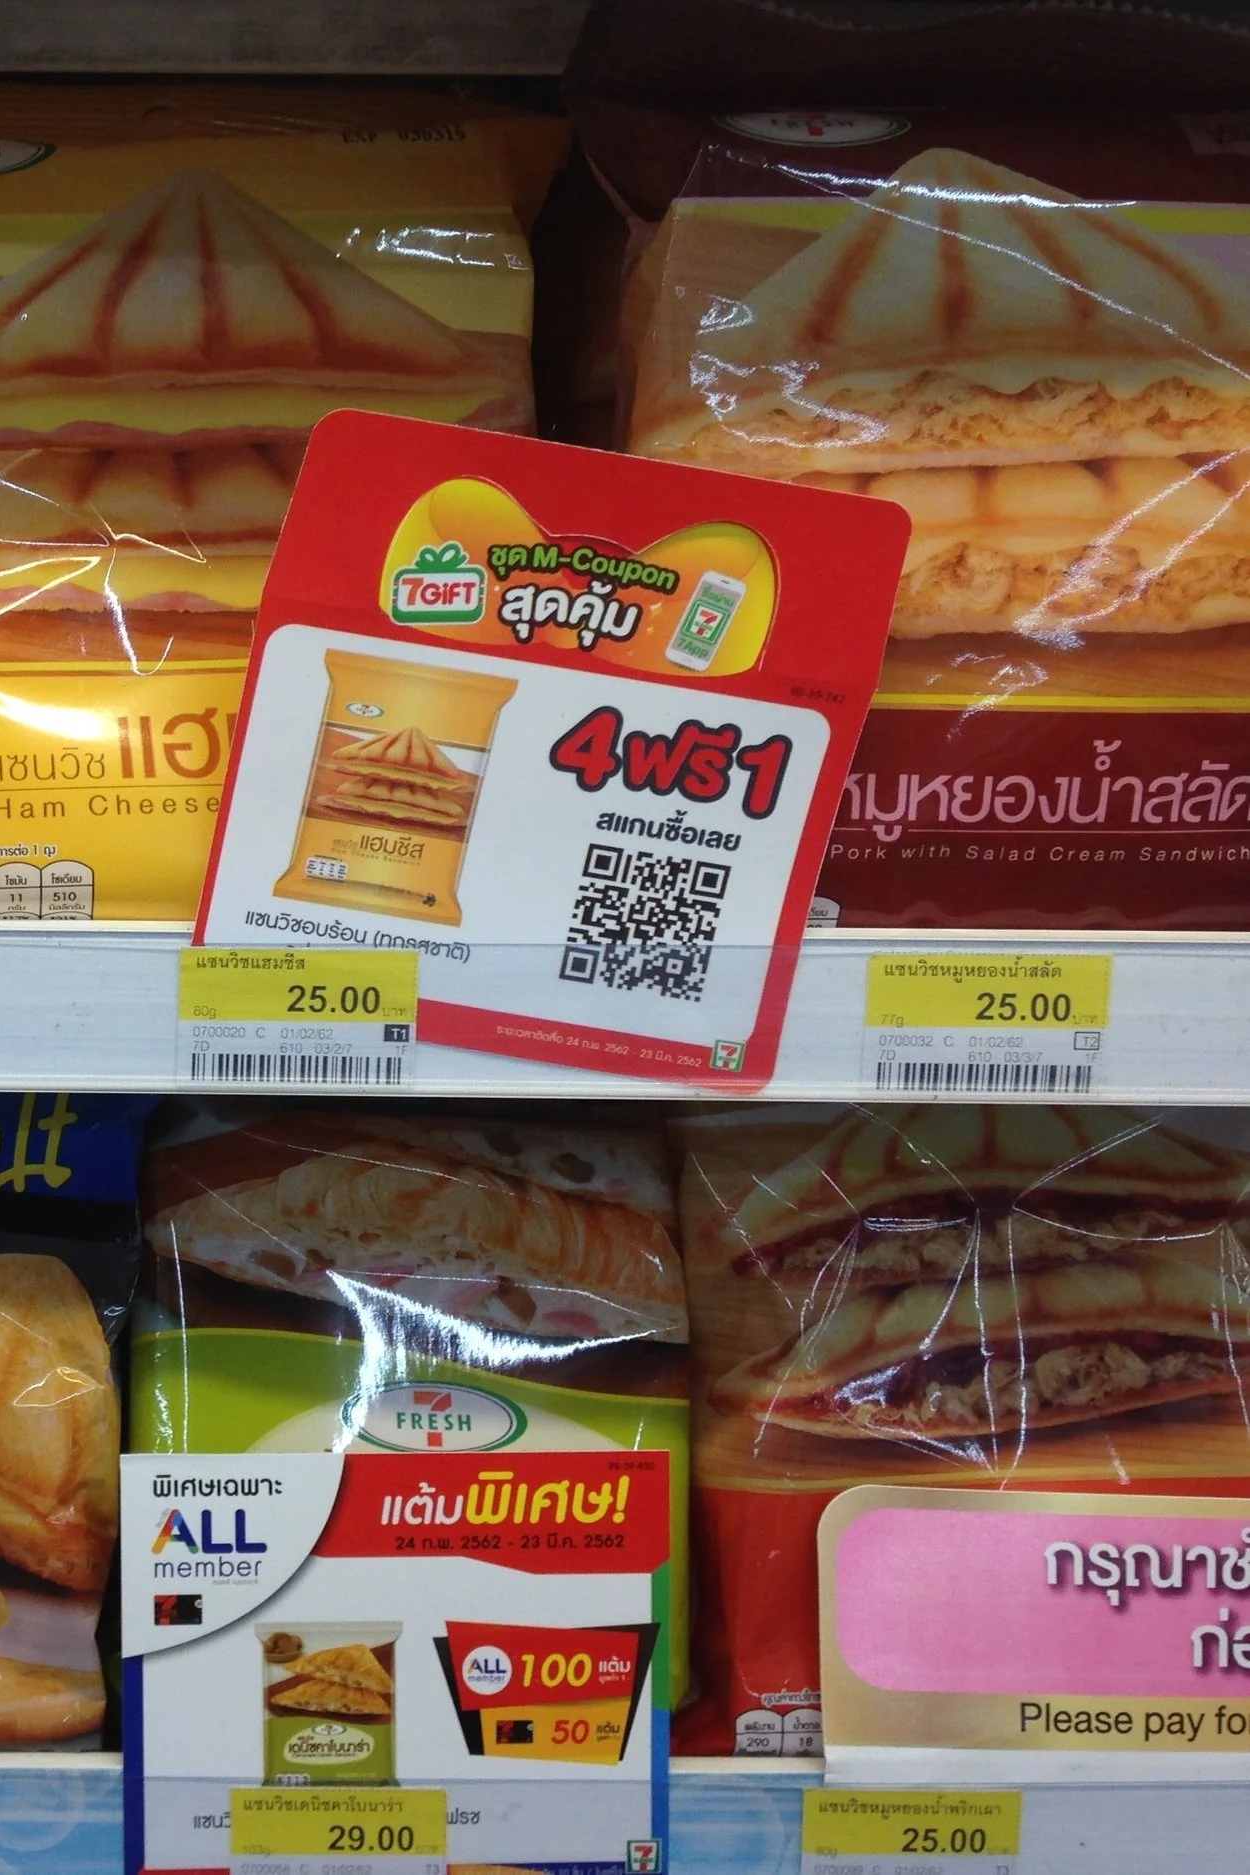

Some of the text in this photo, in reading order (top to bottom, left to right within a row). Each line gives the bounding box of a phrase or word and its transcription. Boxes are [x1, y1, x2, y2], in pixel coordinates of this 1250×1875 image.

[491, 546, 677, 590] ชุด M-Coupon
[501, 580, 639, 648] สุดคุ้ม
[118, 708, 234, 779] แฮ
[89, 795, 220, 816] Cheese
[596, 810, 742, 852] สแกนซื้อเลย
[360, 834, 425, 860] แฮมชีส
[831, 844, 1250, 862] Pork with Salad Cream Sandwich
[9, 894, 23, 903] 11
[53, 891, 76, 902] 510
[245, 910, 368, 944] แซนวิชอบร้อน
[287, 984, 380, 1014] 25.00
[976, 992, 1071, 1022] 25.00
[193, 1026, 246, 1038] 0700020
[256, 1027, 265, 1038] C
[391, 1028, 407, 1040] T1
[879, 1035, 934, 1047] 0700032
[944, 1036, 954, 1047] C
[1083, 1036, 1099, 1047] T2
[194, 1041, 209, 1052] 7D
[605, 1043, 630, 1056] 2562
[677, 1055, 702, 1068] 2562
[879, 1050, 896, 1061] 7D
[396, 1411, 473, 1433] FRESH
[153, 1474, 283, 1497] พิเศษเฉพาะ
[151, 1508, 268, 1555] ALL
[396, 1536, 415, 1550] 24
[461, 1536, 501, 1549] 2562
[521, 1535, 540, 1549] 23
[584, 1535, 624, 1548] 2562
[154, 1557, 262, 1578] member
[468, 1653, 630, 1687] ALL 100 แต้ม
[552, 1719, 590, 1744] 50
[1020, 1703, 1250, 1742] Please pay fo
[328, 1825, 414, 1851] 29.00
[901, 1828, 987, 1854] 25.00
